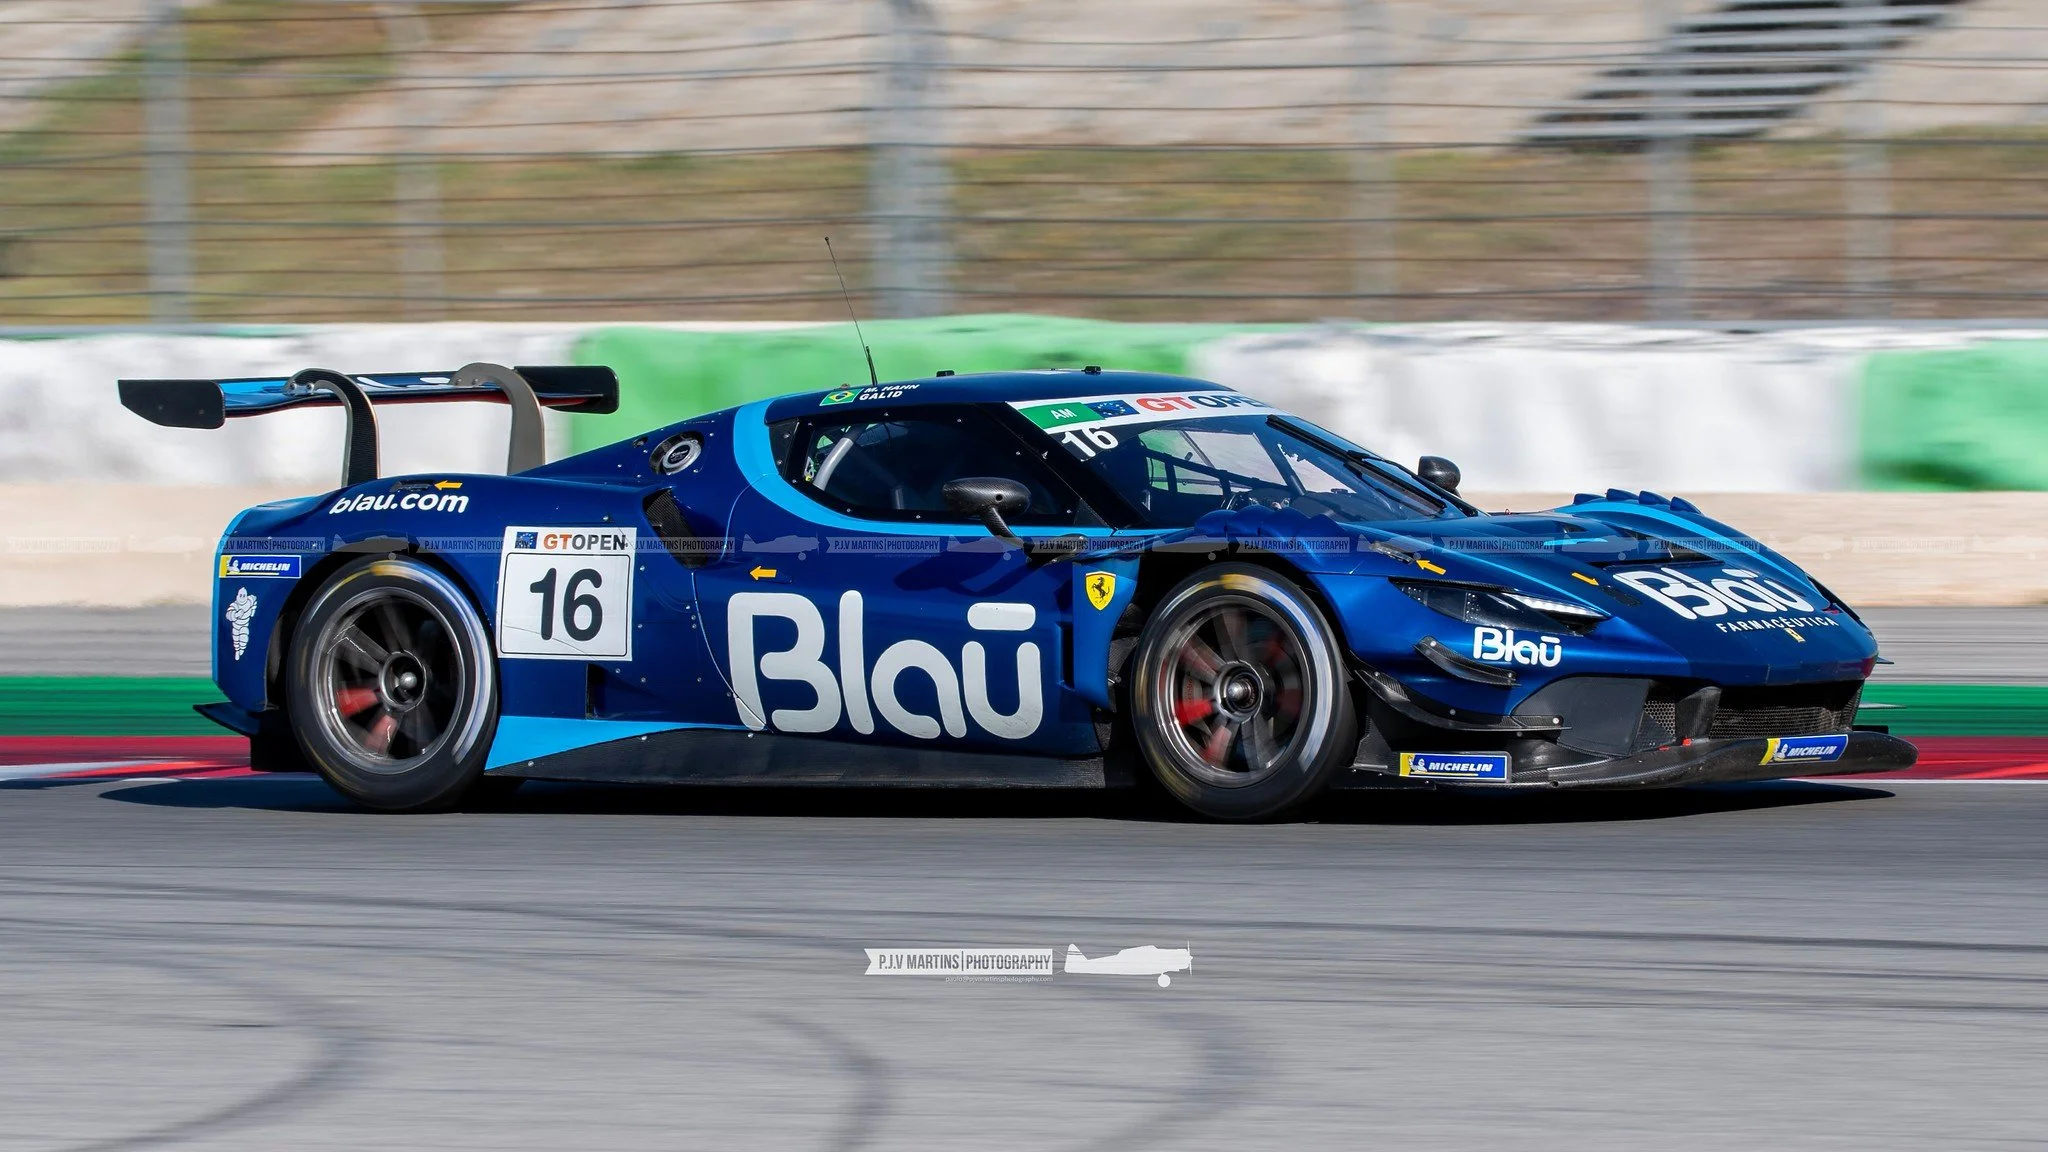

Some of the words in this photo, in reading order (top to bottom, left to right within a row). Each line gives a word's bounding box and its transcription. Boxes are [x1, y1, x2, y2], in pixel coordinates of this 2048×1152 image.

[859, 391, 903, 401] GALID
[1136, 395, 1268, 412] GTOPE
[1050, 408, 1078, 420] AM
[1062, 427, 1119, 458] 16
[328, 493, 470, 514] blau.com
[240, 562, 291, 571] MICHELIN
[529, 567, 603, 642] 16
[1787, 745, 1838, 757] MICHELIN
[1428, 762, 1494, 772] MICHELIN
